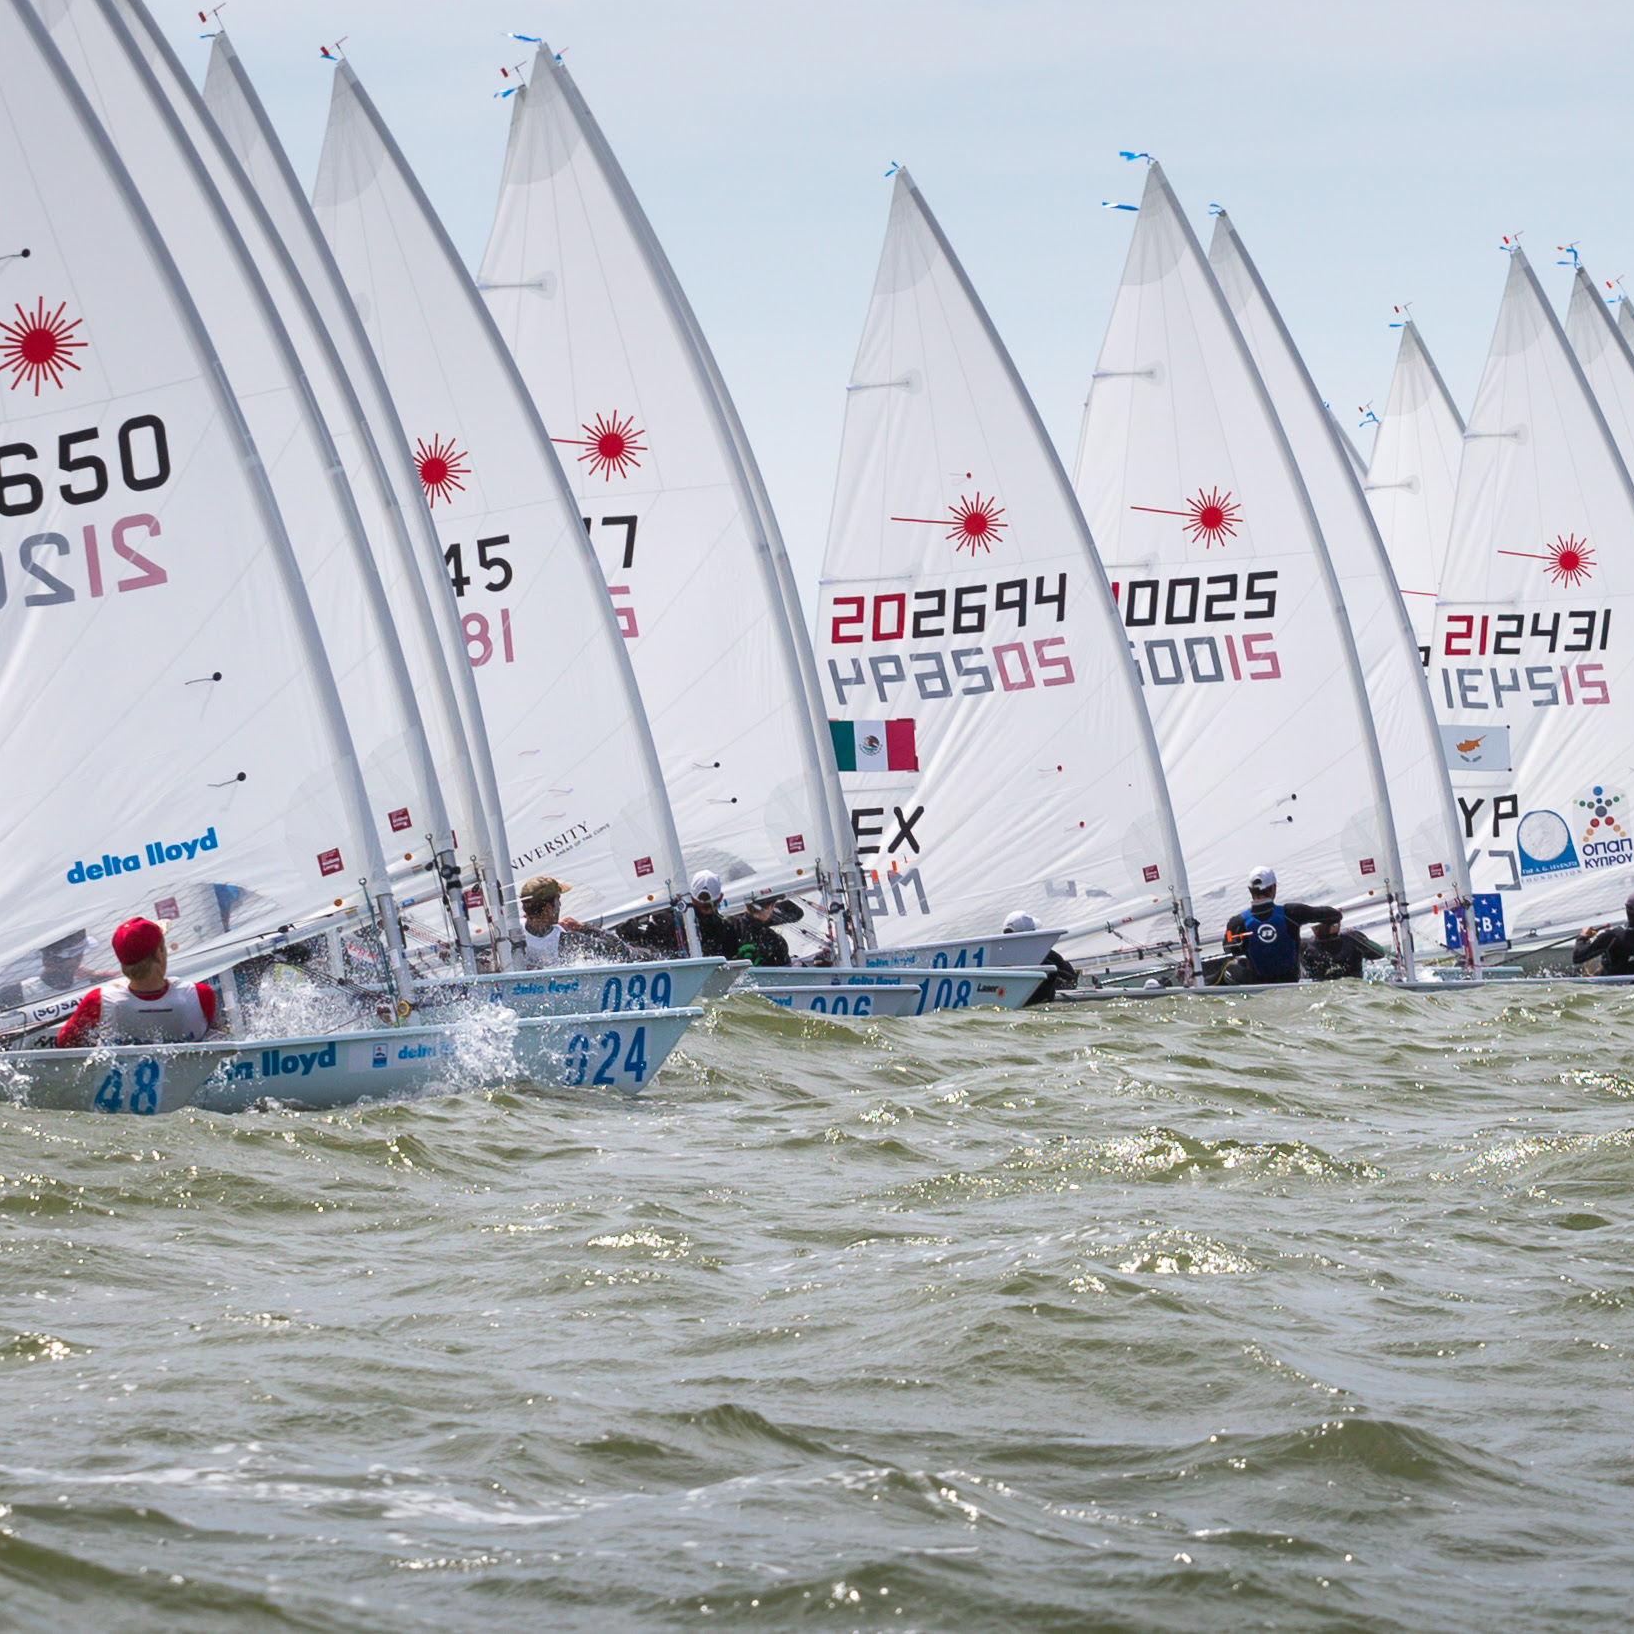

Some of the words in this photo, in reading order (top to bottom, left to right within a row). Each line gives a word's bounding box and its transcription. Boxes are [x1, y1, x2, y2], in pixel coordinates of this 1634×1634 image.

[831, 572, 1067, 644] 202694
[1444, 609, 1612, 656] 212431
[67, 854, 141, 884] delta
[145, 826, 219, 867] lloyd
[600, 972, 672, 1013] 089
[916, 978, 971, 1016] 108
[261, 1041, 337, 1077] lloyd
